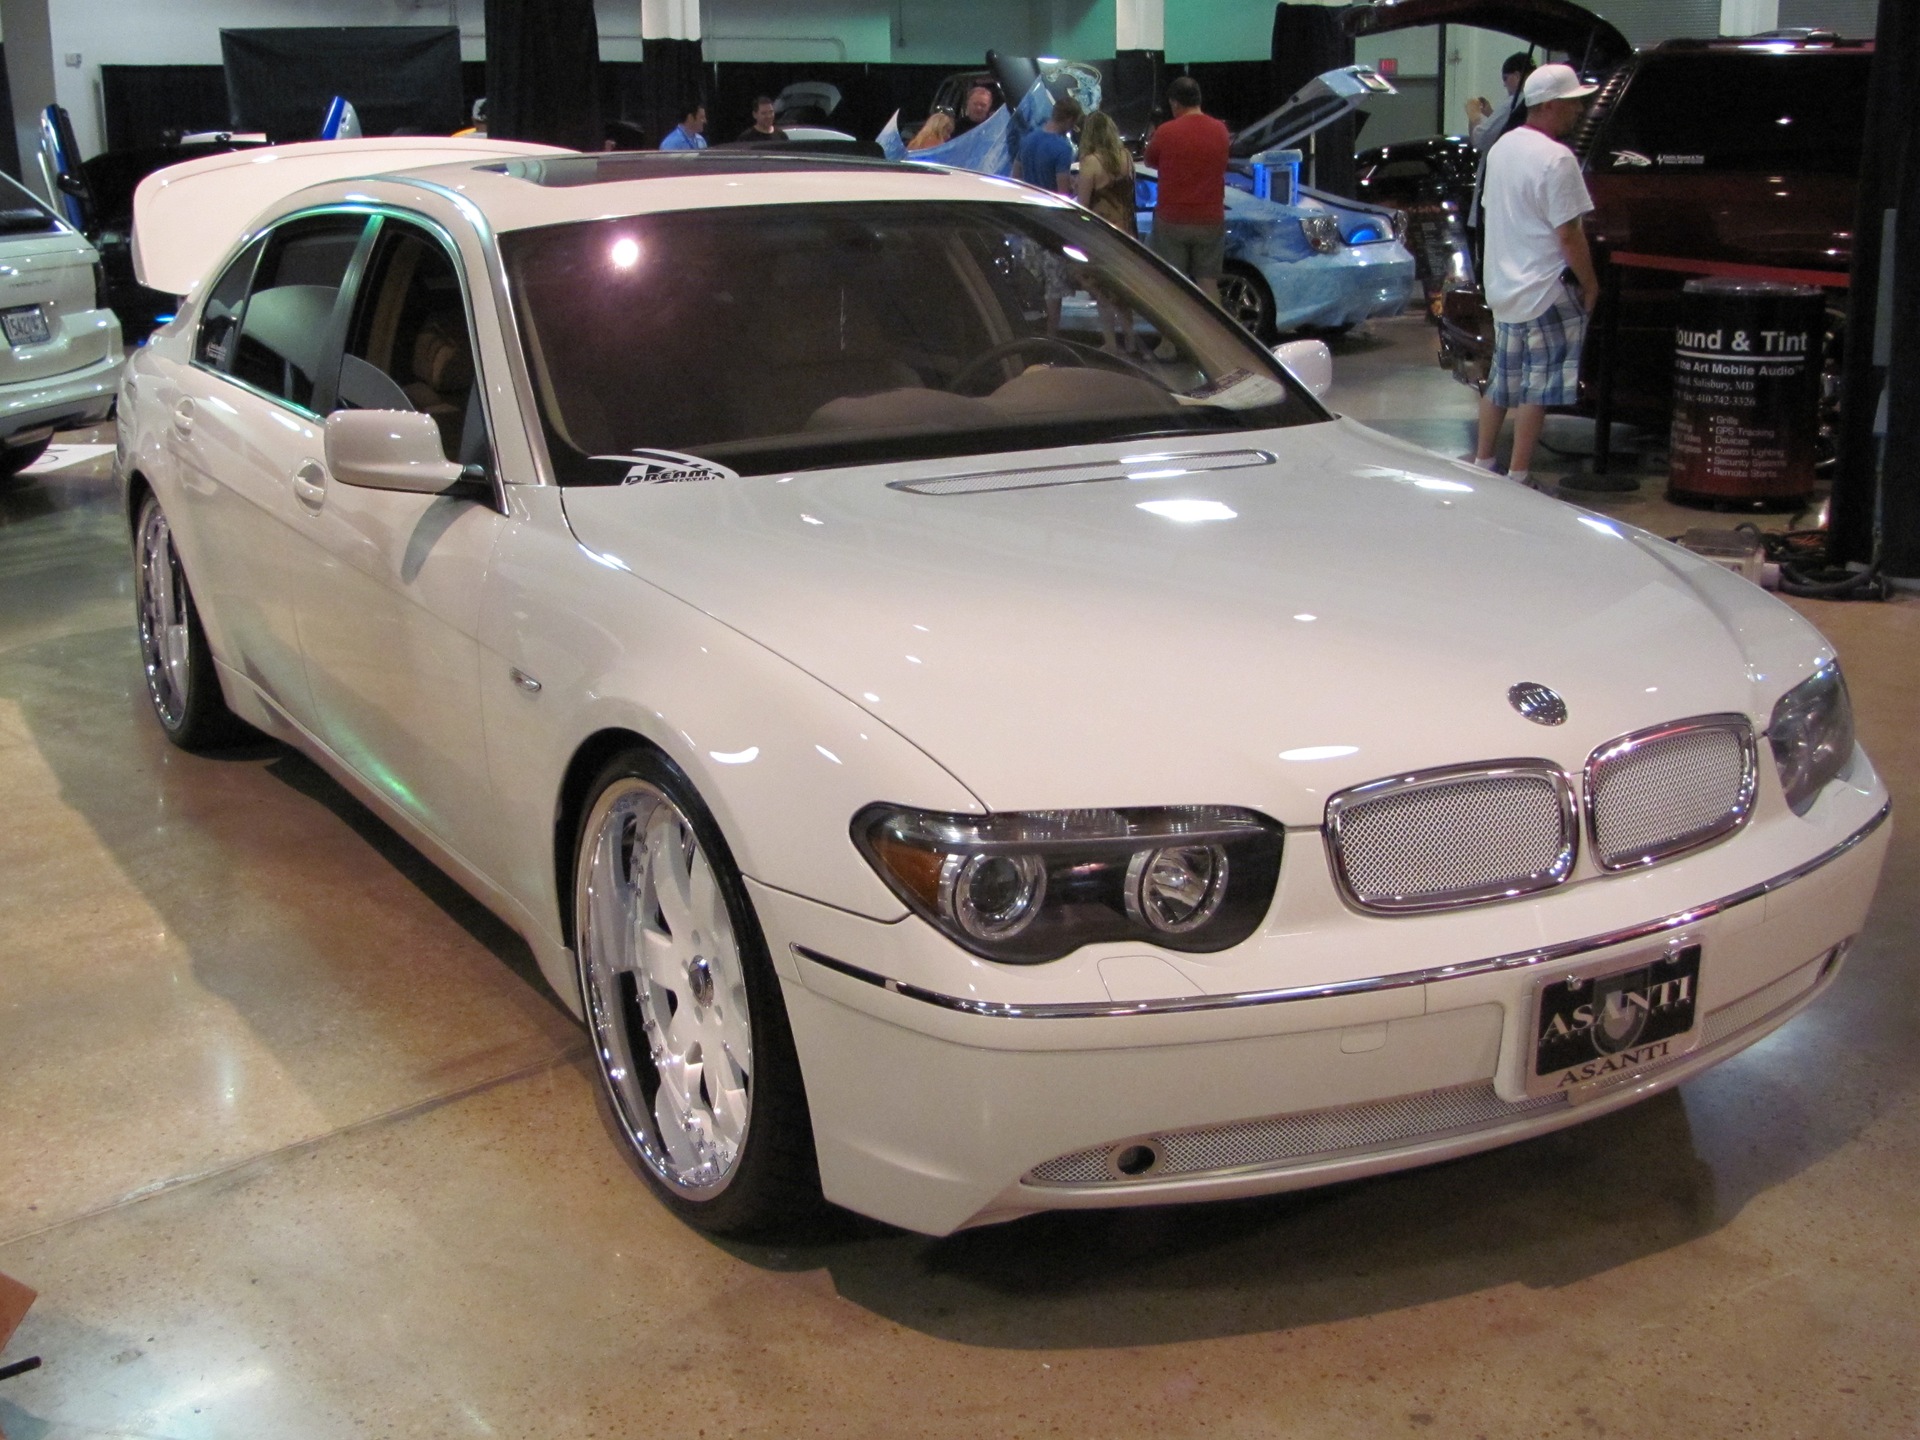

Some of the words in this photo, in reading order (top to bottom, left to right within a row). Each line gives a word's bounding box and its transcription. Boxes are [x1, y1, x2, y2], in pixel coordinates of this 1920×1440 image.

[1675, 329, 1722, 350] ound
[1731, 331, 1750, 351] &
[1761, 331, 1808, 352] Tint
[1693, 361, 1709, 373] Art
[1712, 363, 1755, 376] Mobile
[1735, 380, 1755, 391] MD
[1715, 426, 1735, 436] GPS
[1737, 427, 1775, 439] Tracking
[1714, 446, 1749, 457] Custom
[1713, 456, 1750, 468] Security
[624, 469, 709, 485] DREAM
[1713, 466, 1748, 477] Remote
[1541, 975, 1692, 1041] ASANTI
[1556, 1040, 1671, 1088] ASANTI
